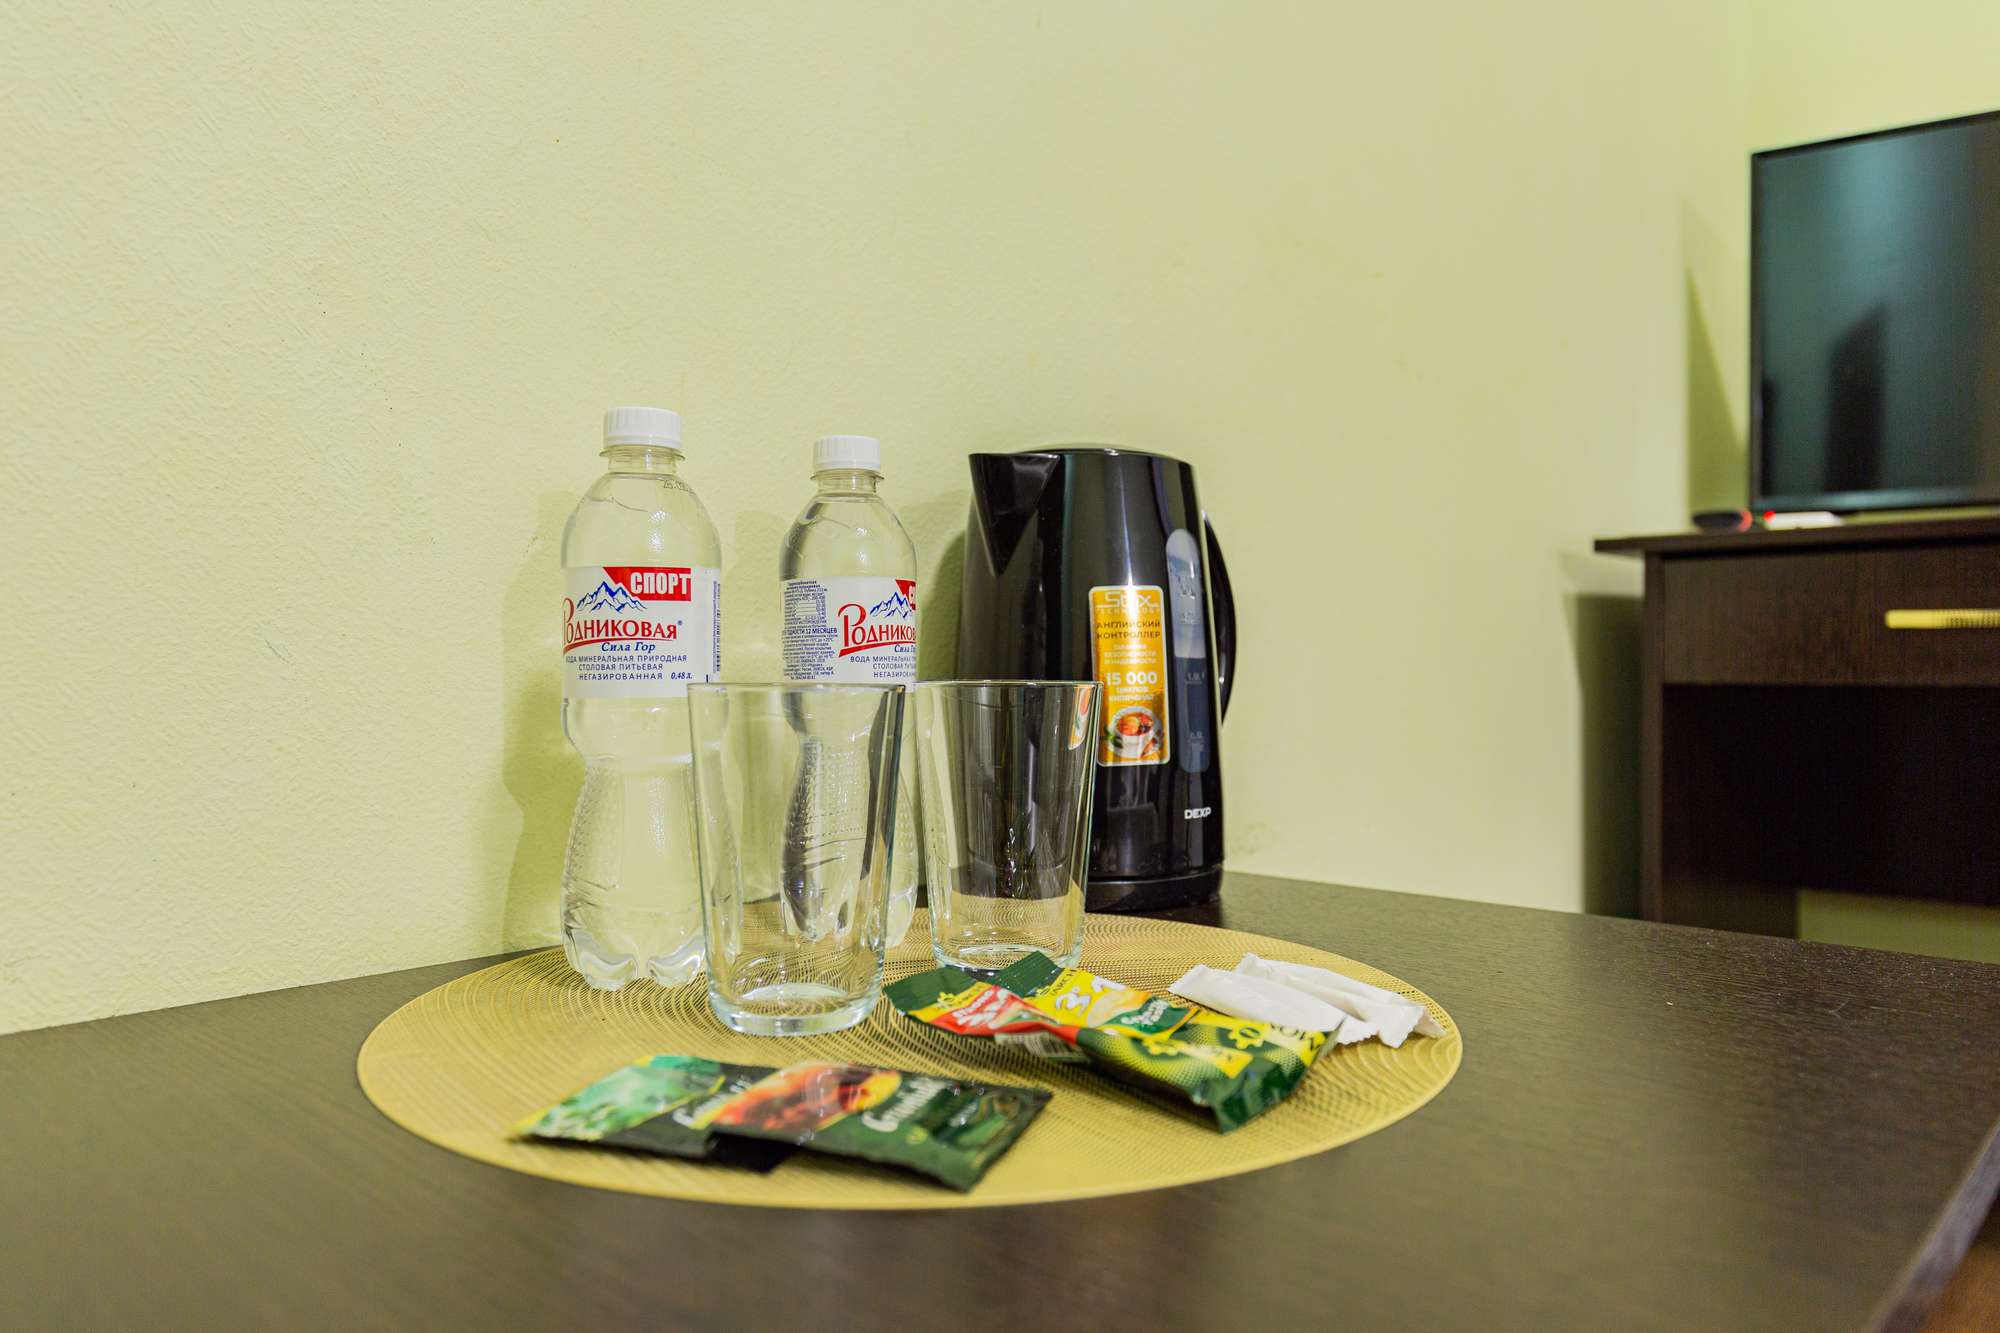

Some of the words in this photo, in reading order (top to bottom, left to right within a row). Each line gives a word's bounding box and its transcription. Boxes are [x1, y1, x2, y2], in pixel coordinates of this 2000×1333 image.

[630, 571, 691, 595] СПОРТ
[1096, 631, 1161, 639] КОНТРОЛЛЕР
[601, 641, 631, 652] Сила
[634, 641, 656, 653] Гор
[637, 654, 687, 663] ПРИРОДНАЯ
[850, 655, 870, 663] ВОДА
[578, 663, 616, 671] СТОЛОВАЯ
[619, 663, 663, 671] ПИТЬЕВАЯ
[872, 662, 903, 670] СТОЛОВАЯ
[579, 672, 663, 680] НЕГАЗИРОВАННАЯ
[1105, 672, 1121, 686] 15
[1126, 671, 1157, 685] 000
[1183, 806, 1212, 819] DEXP
